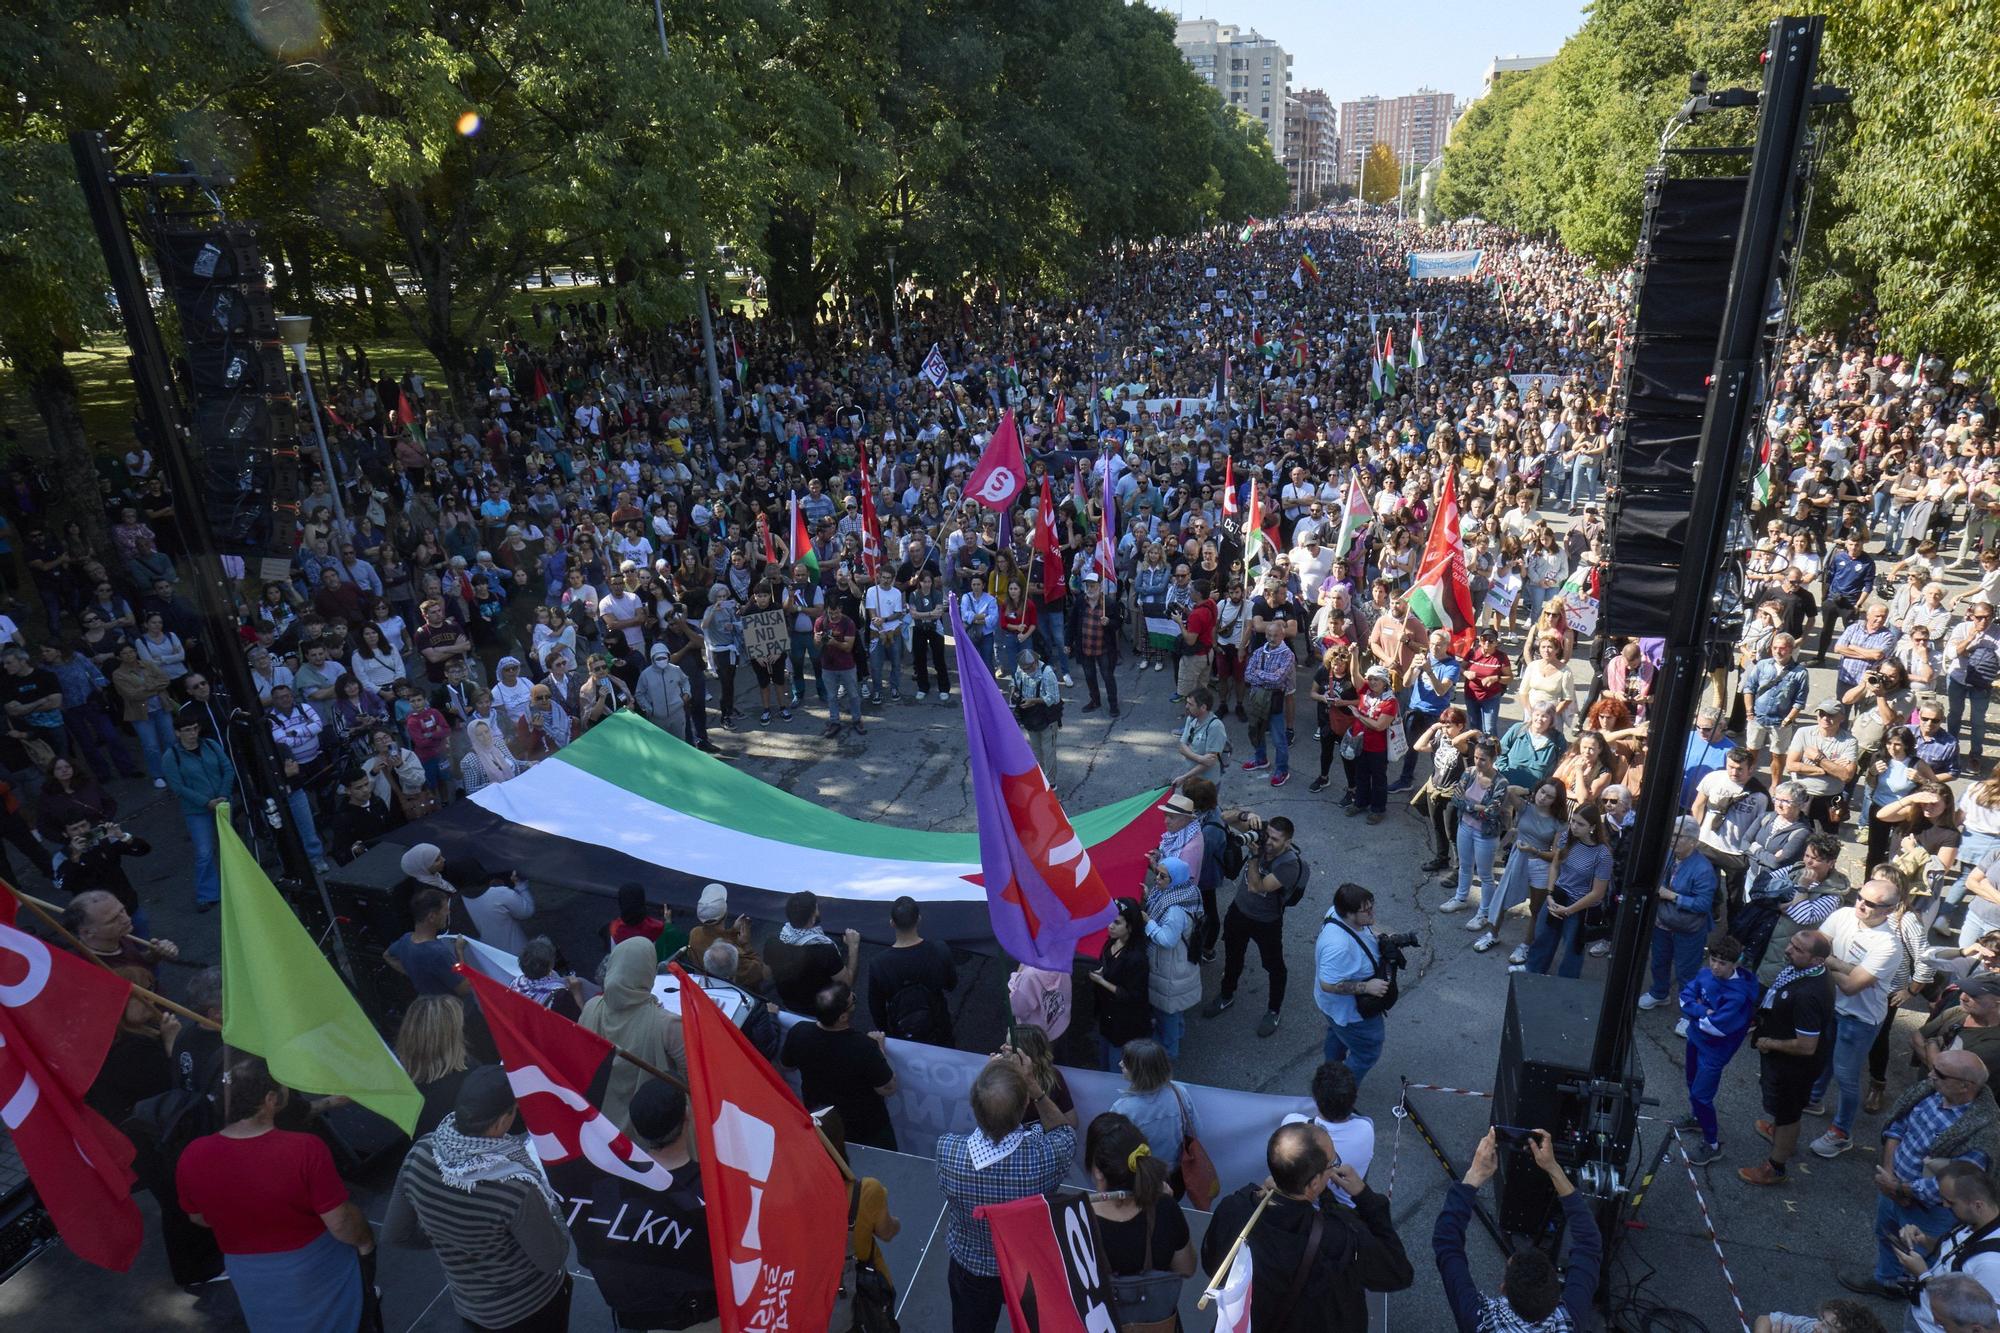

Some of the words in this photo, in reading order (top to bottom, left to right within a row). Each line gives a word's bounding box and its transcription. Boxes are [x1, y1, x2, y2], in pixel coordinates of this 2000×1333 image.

[742, 611, 784, 629] PAUSA
[755, 627, 775, 643] NO
[747, 644, 764, 659] ES
[766, 638, 791, 656] PAZ
[552, 1188, 692, 1250] T-LKN
